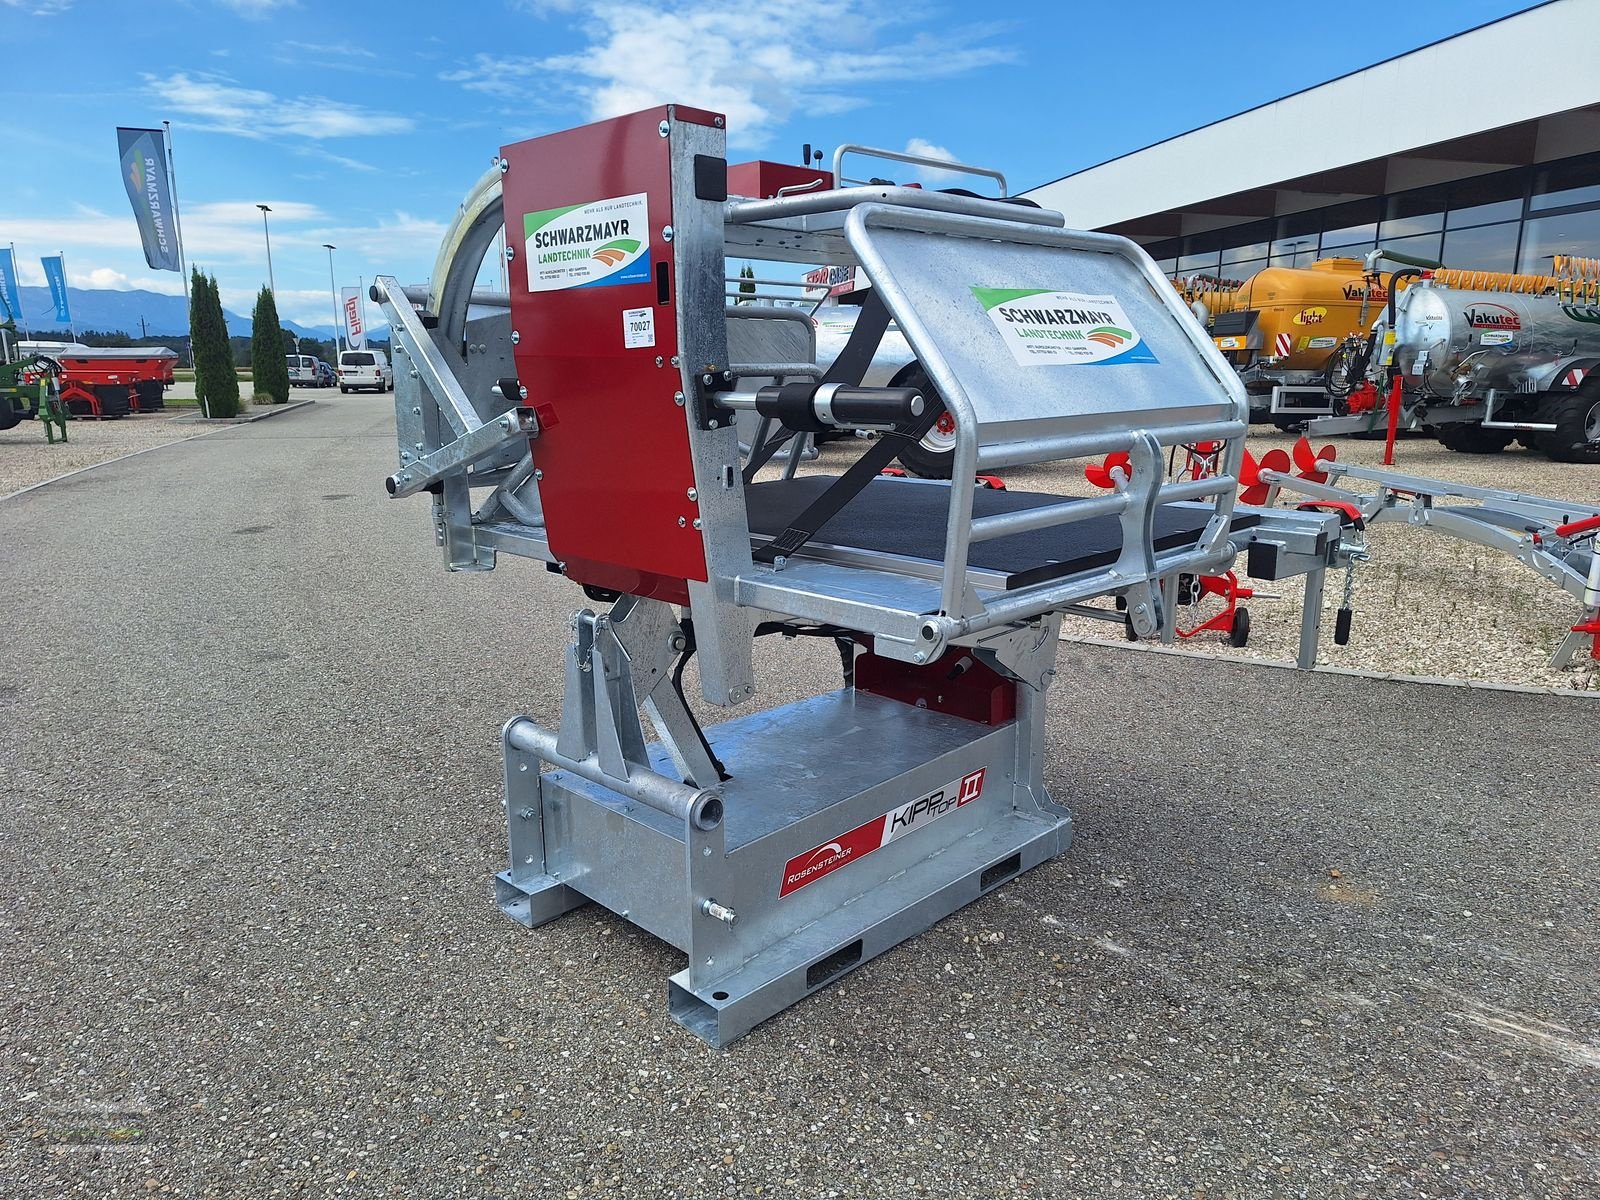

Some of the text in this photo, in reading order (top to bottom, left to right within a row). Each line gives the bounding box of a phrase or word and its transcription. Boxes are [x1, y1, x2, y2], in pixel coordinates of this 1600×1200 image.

[535, 219, 630, 249] SCHWARZMAYR
[538, 248, 591, 264] LANDTECHNIK
[630, 320, 651, 332] 70027
[998, 307, 1116, 326] SCHWARZMAYR
[1300, 309, 1323, 325] light
[1463, 308, 1521, 328] Vakutec
[1014, 327, 1087, 340] LANDTECHNIK
[890, 790, 945, 833] KIPP
[930, 796, 957, 817] TOP
[787, 847, 852, 885] ROSENSTEINER
